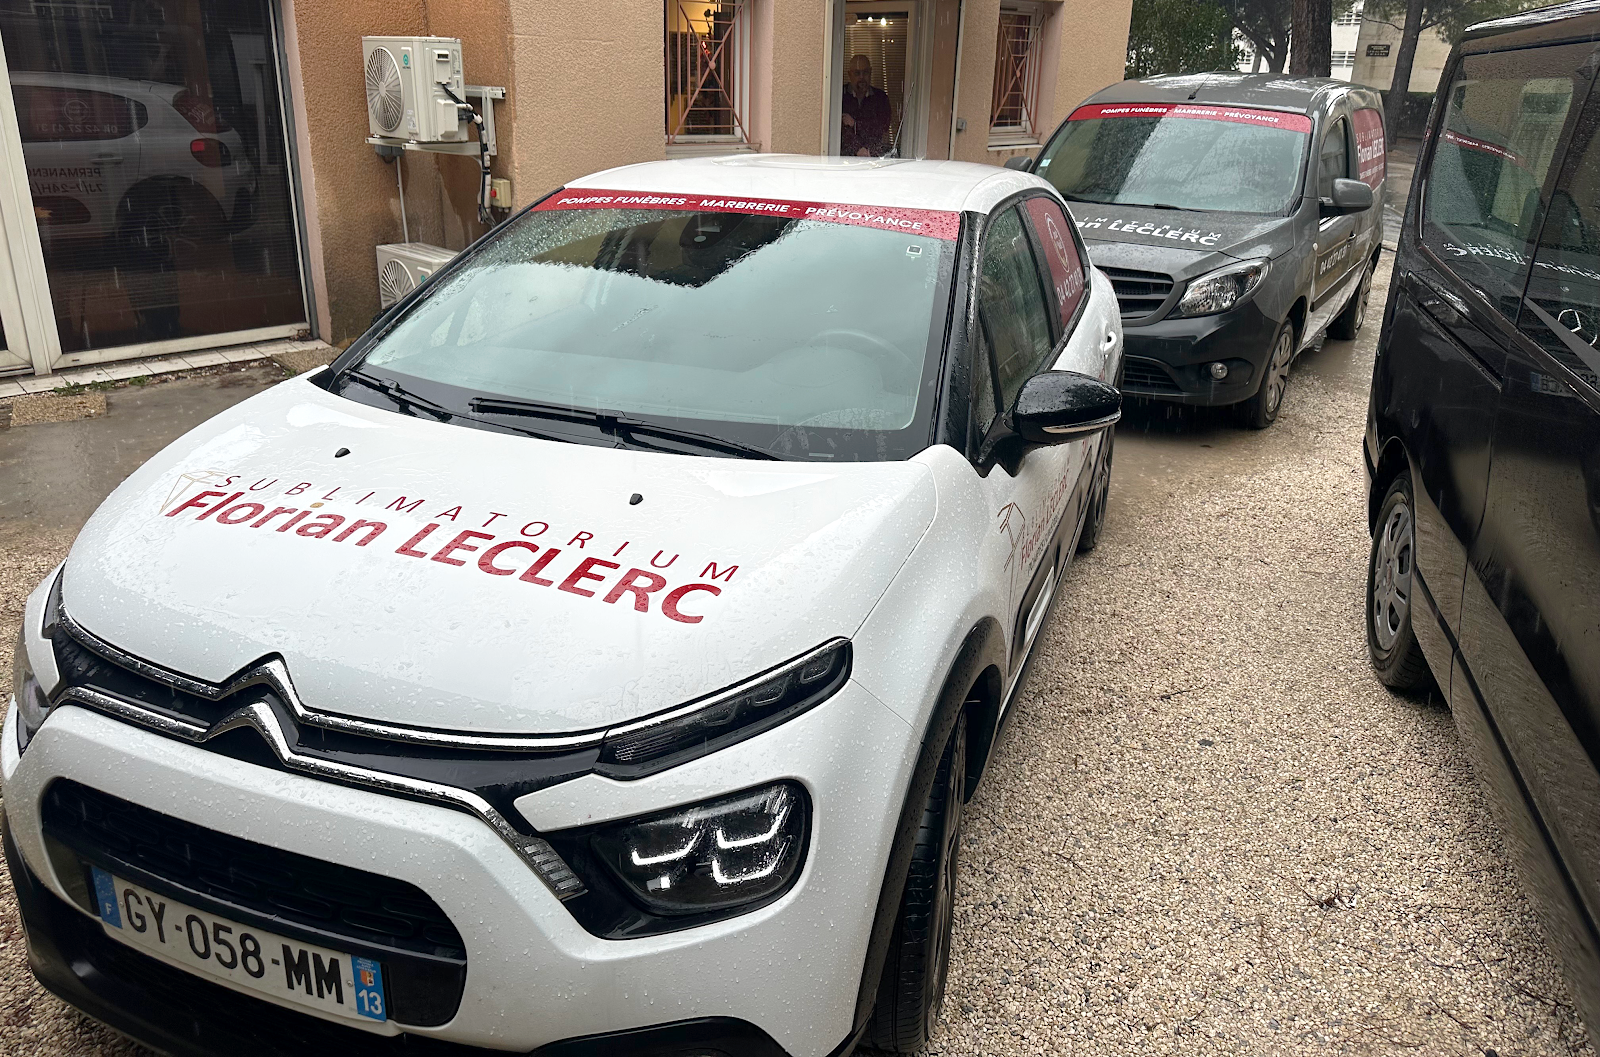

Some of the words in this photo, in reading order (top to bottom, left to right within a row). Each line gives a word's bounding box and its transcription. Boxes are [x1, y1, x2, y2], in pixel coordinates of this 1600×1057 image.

[1101, 107, 1130, 115] POMPES
[1130, 106, 1167, 114] FUNÈBRES
[1173, 108, 1217, 117] MARBRERIE
[1224, 111, 1280, 123] PRÉVOYANCE
[557, 195, 613, 205] POMPES
[612, 195, 688, 206] FUNÈBRES
[699, 198, 791, 213] MARBRERIE
[804, 206, 923, 230] PRÉVOYANCE
[1107, 221, 1219, 246] LECLERC
[215, 475, 740, 582] SUBLIMATORIUM
[165, 490, 388, 547] Florian
[395, 522, 722, 624] LECLERC
[104, 902, 112, 915] F
[123, 888, 345, 1005] GY-058-MM
[358, 988, 382, 1015] 13
